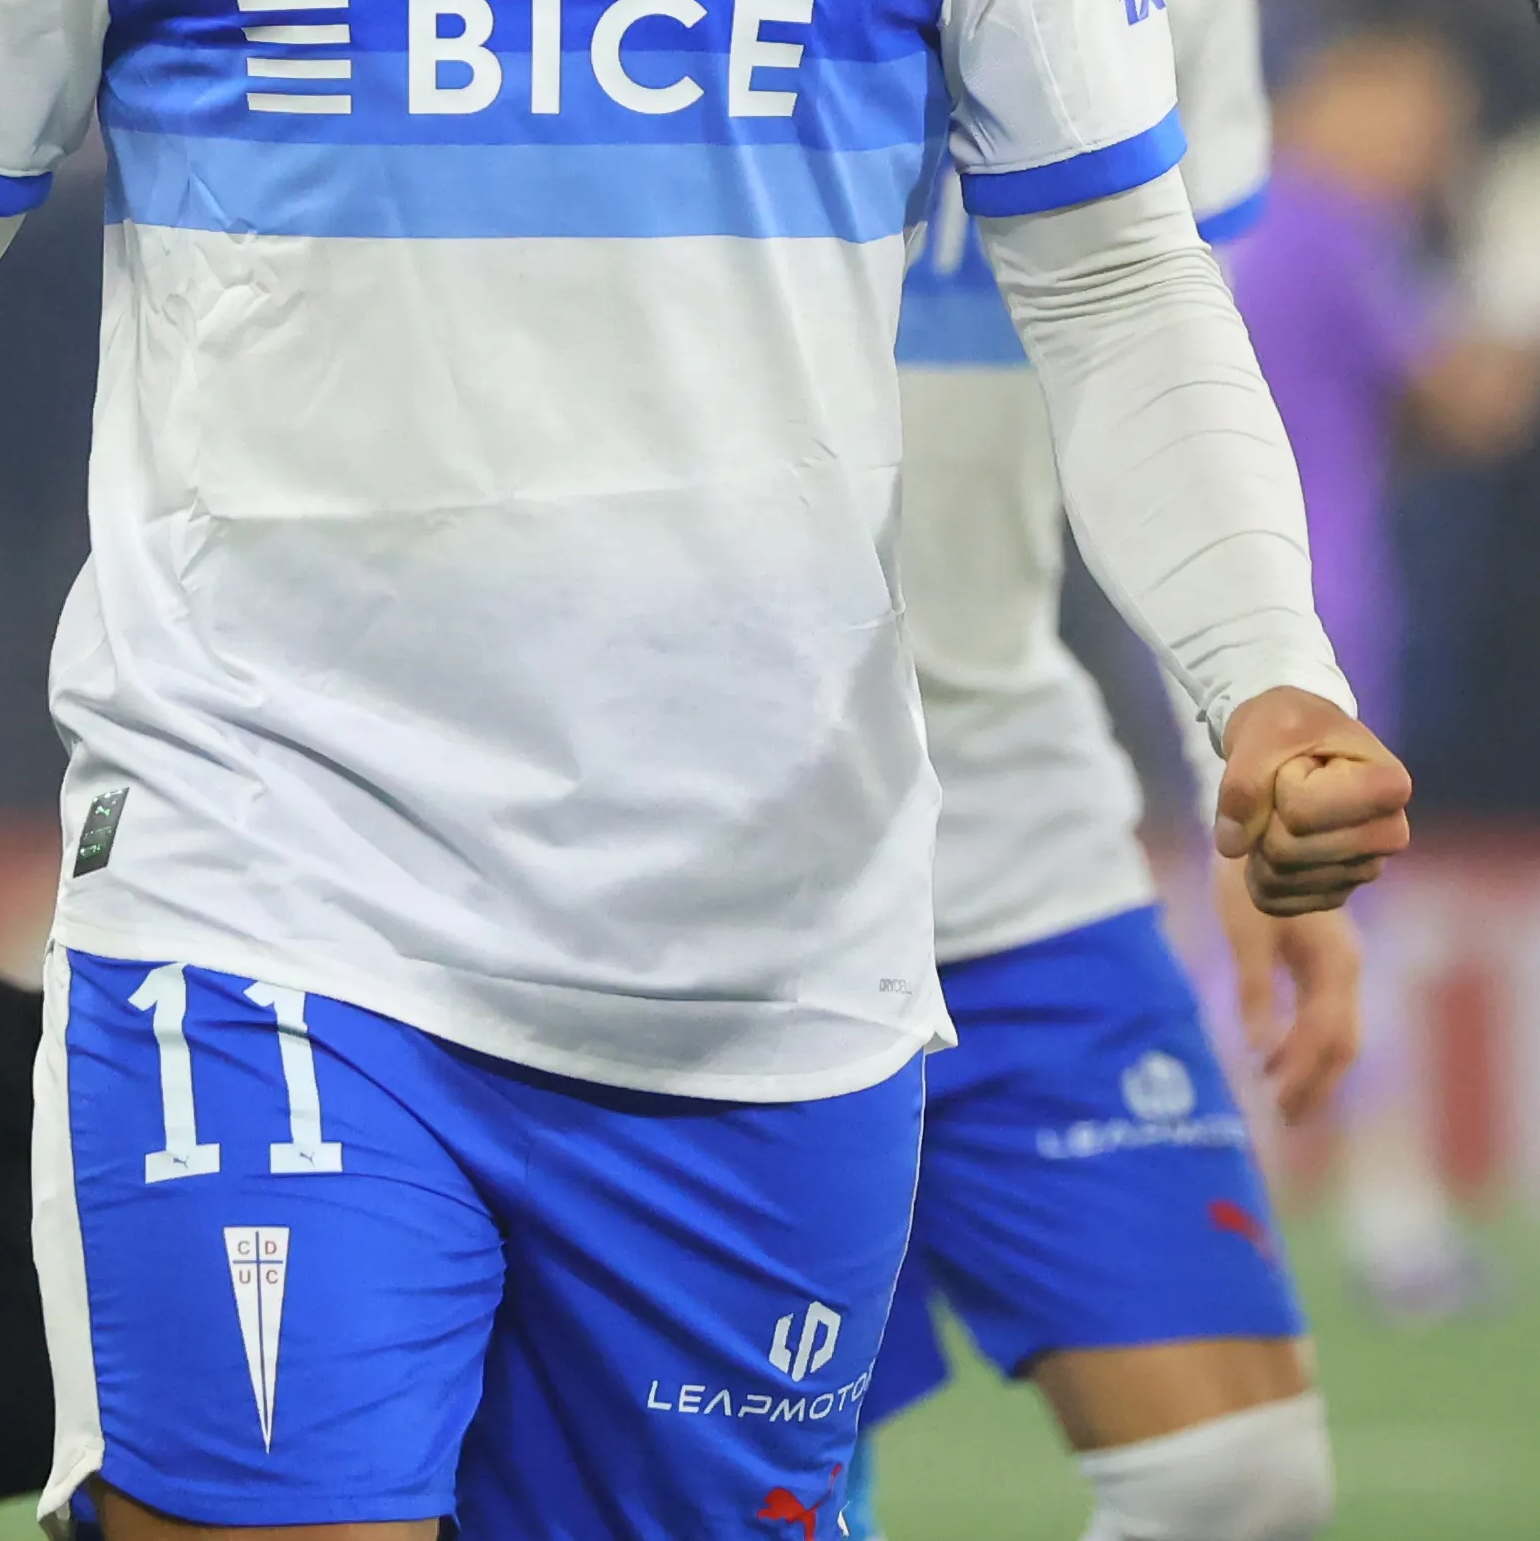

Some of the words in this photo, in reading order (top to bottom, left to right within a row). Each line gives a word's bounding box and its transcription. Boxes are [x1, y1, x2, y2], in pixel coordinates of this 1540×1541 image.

[127, 962, 343, 1184] 11
[264, 1240, 278, 1256] D
[265, 1269, 279, 1285] C
